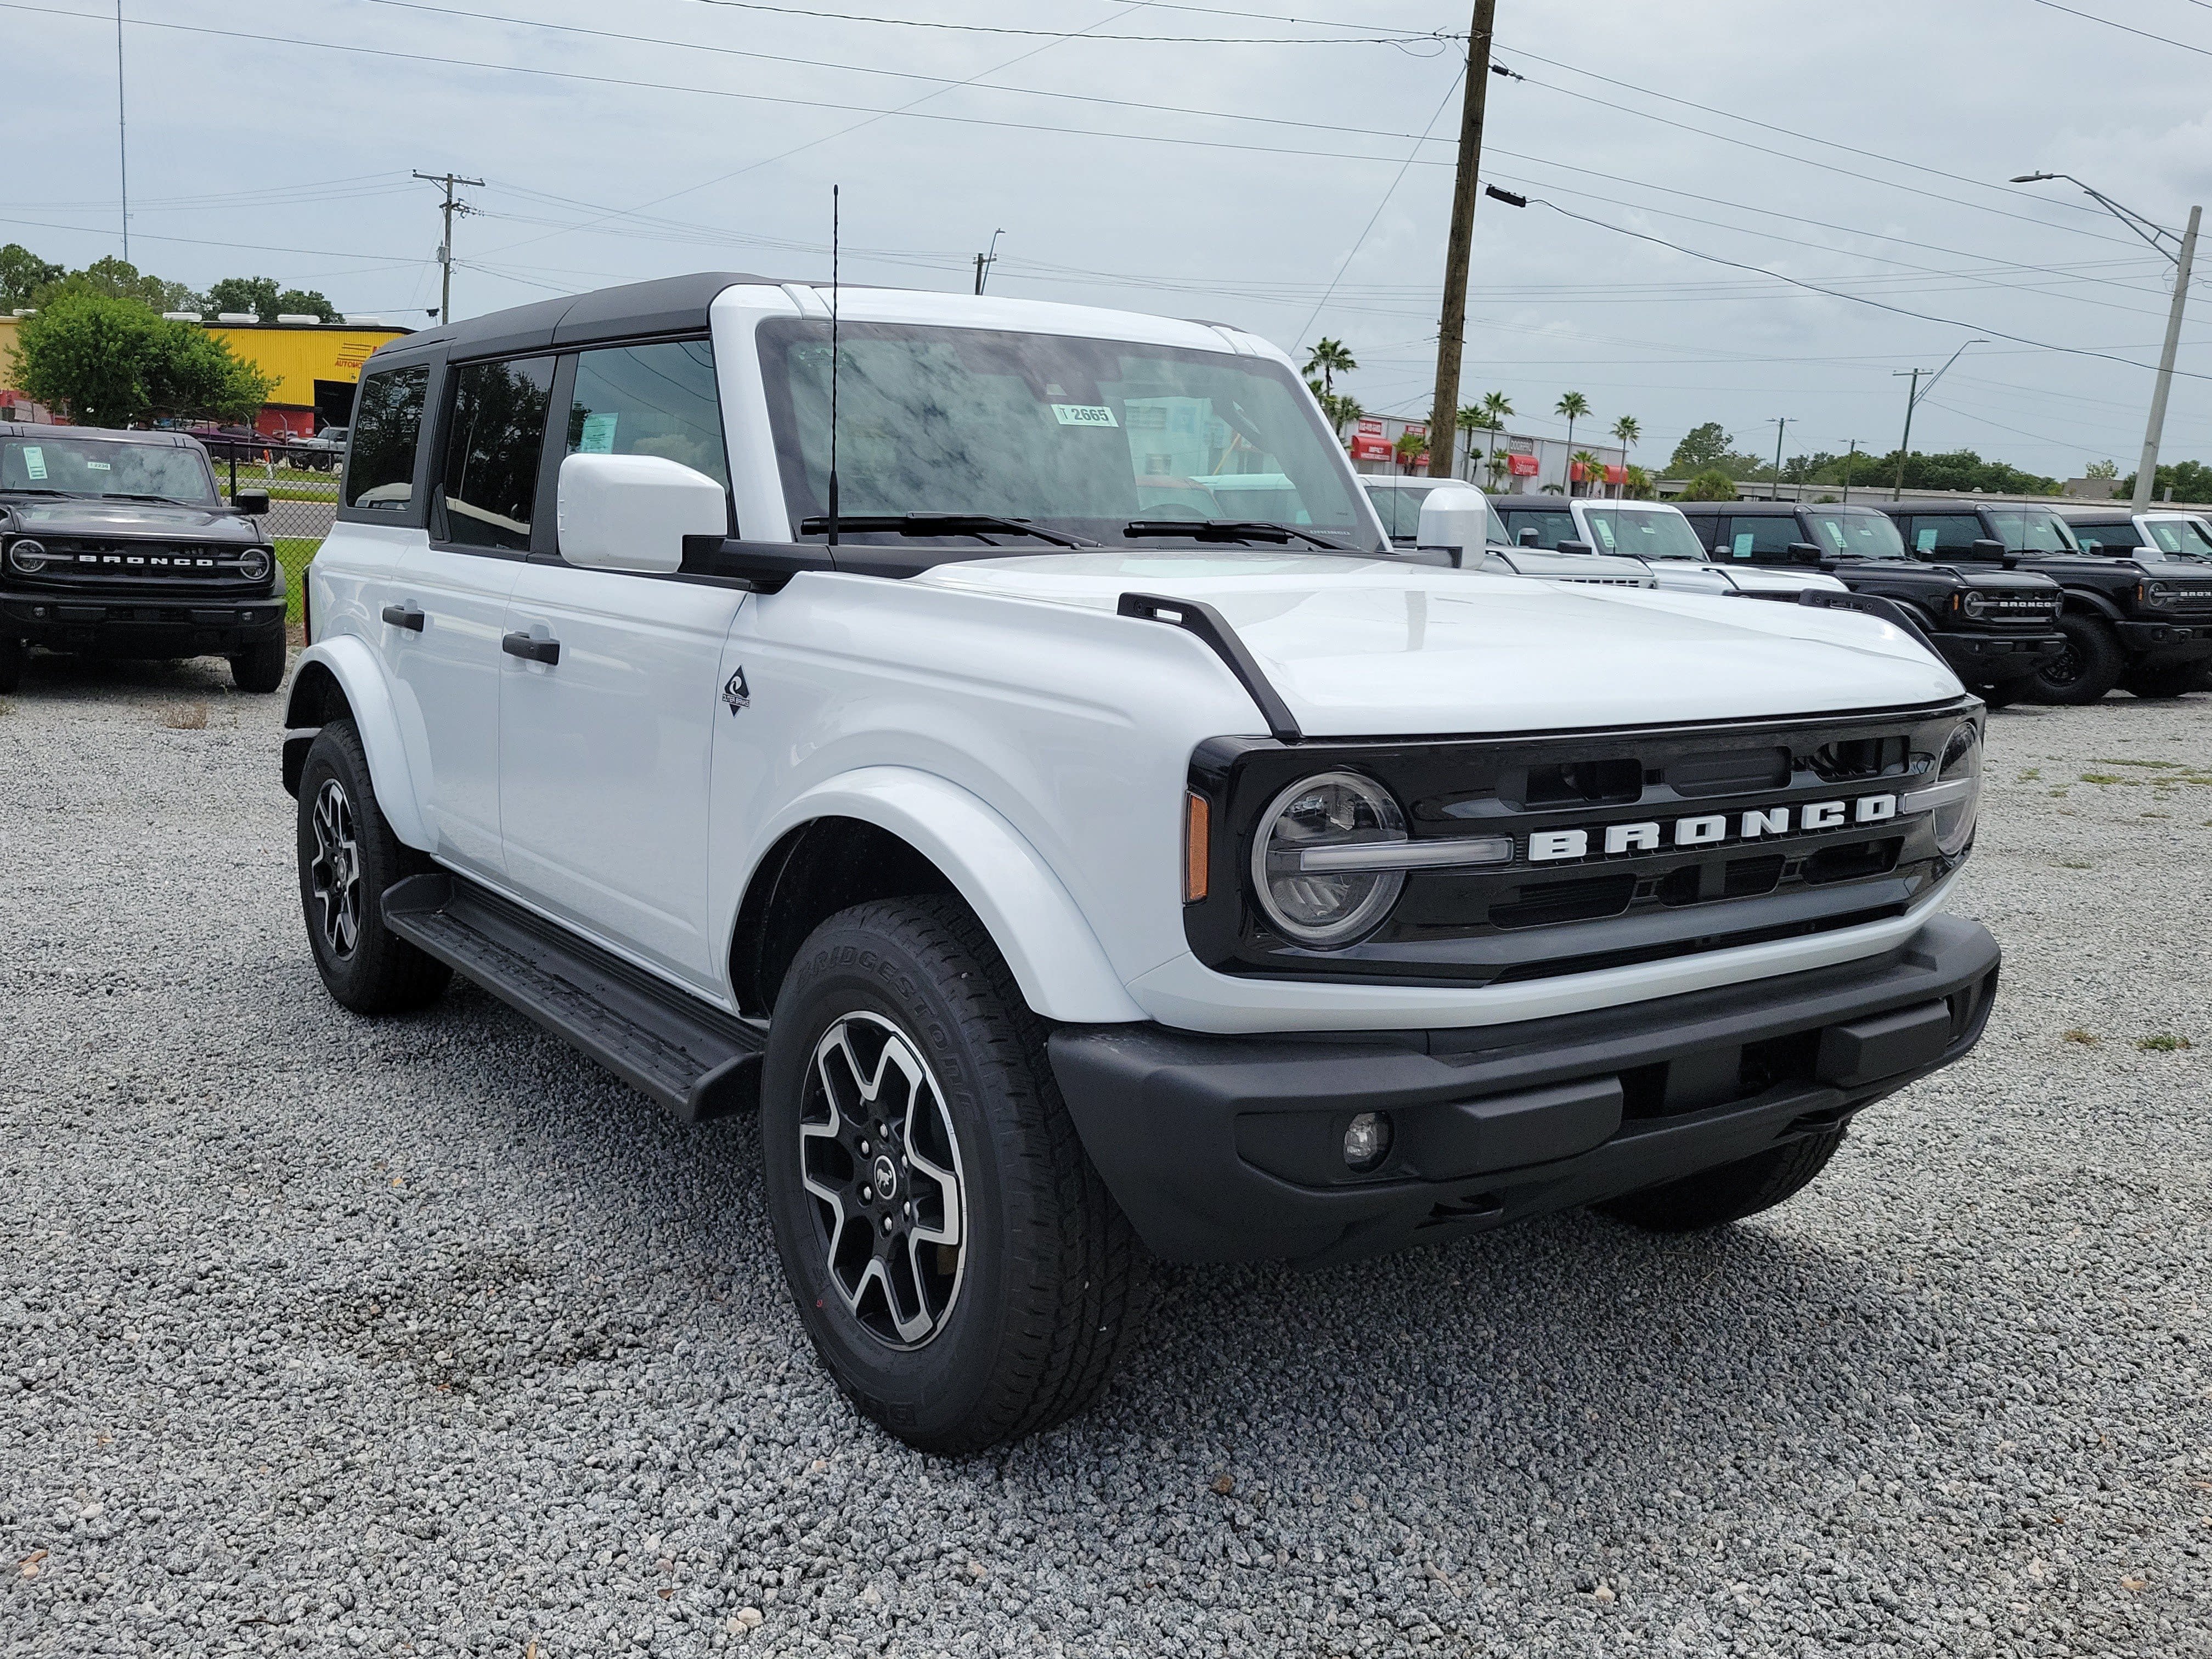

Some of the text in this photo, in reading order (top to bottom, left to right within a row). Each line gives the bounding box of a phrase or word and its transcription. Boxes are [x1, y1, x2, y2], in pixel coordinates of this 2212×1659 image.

[1059, 408, 1109, 422] T 2665
[79, 555, 213, 566] BRONCO
[1528, 794, 1896, 861] BRONCO
[796, 945, 982, 1121] BRIDGESTONE
